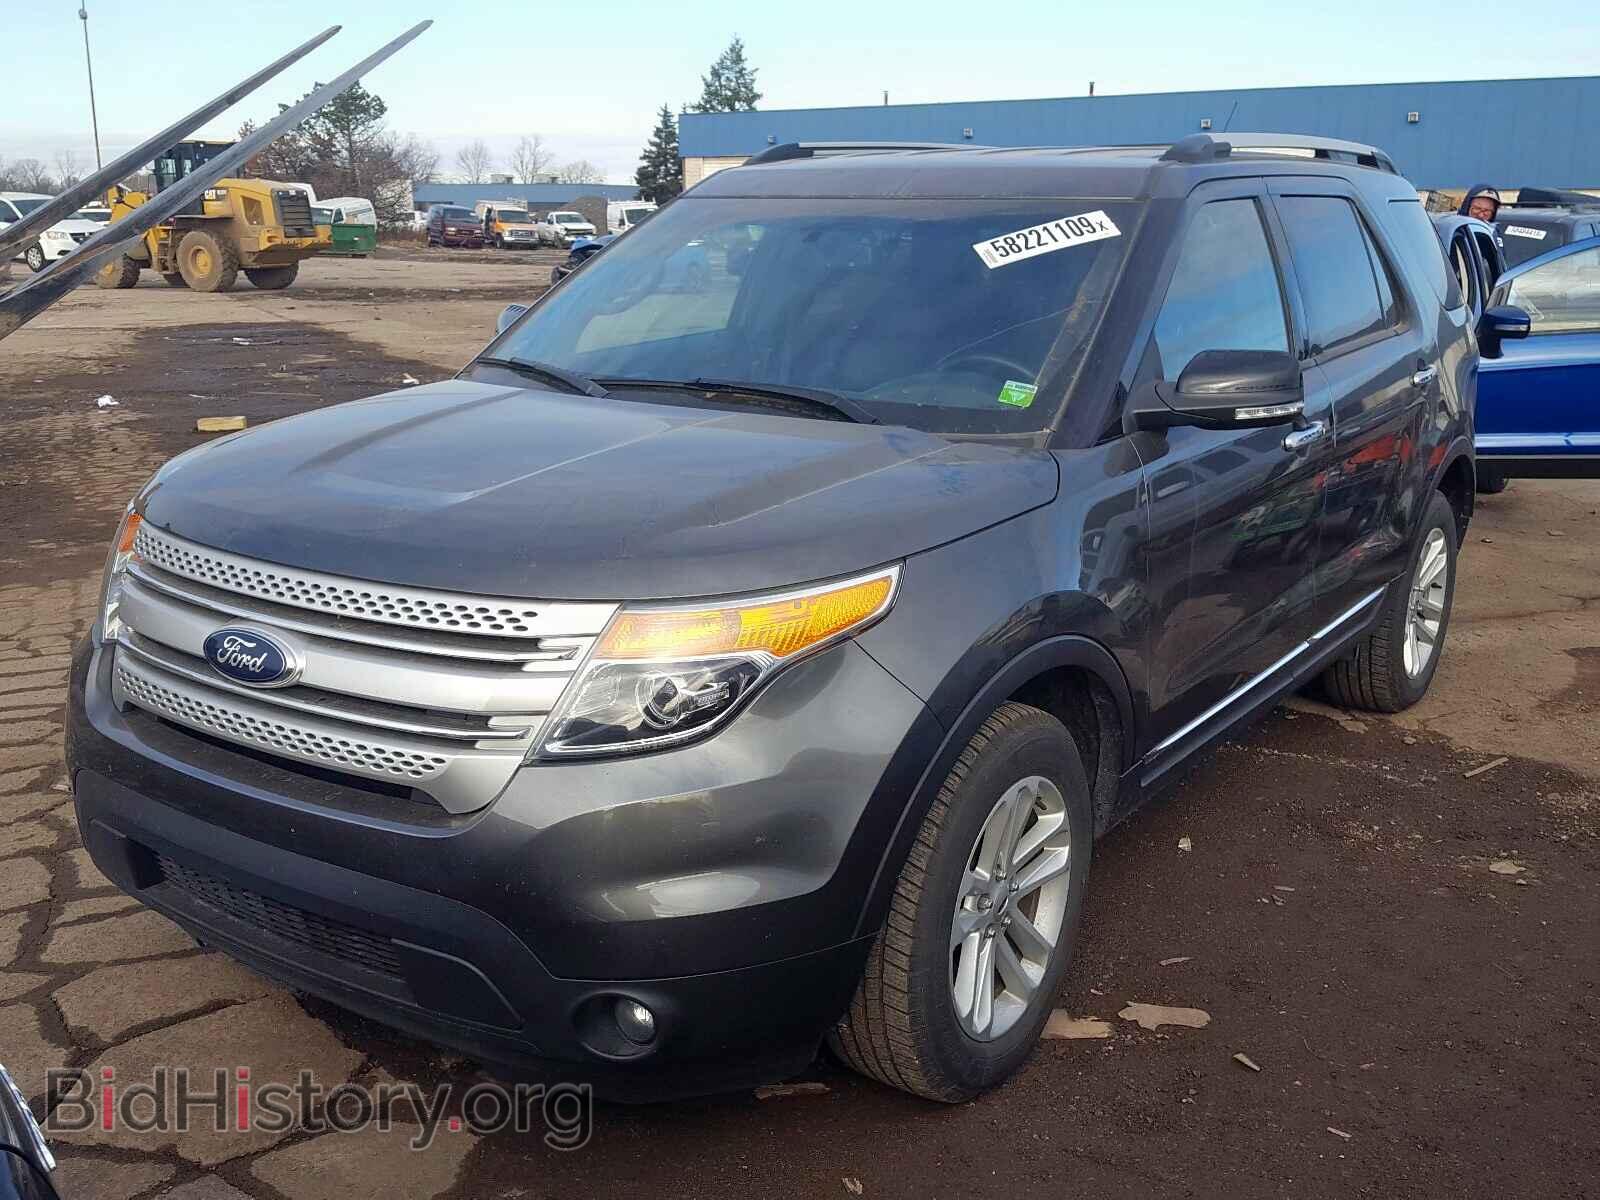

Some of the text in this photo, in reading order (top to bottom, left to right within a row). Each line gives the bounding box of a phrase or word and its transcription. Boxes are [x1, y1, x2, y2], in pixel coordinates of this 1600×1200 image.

[204, 189, 216, 200] CAT
[990, 216, 1097, 258] 58221109
[217, 635, 267, 672] Ford
